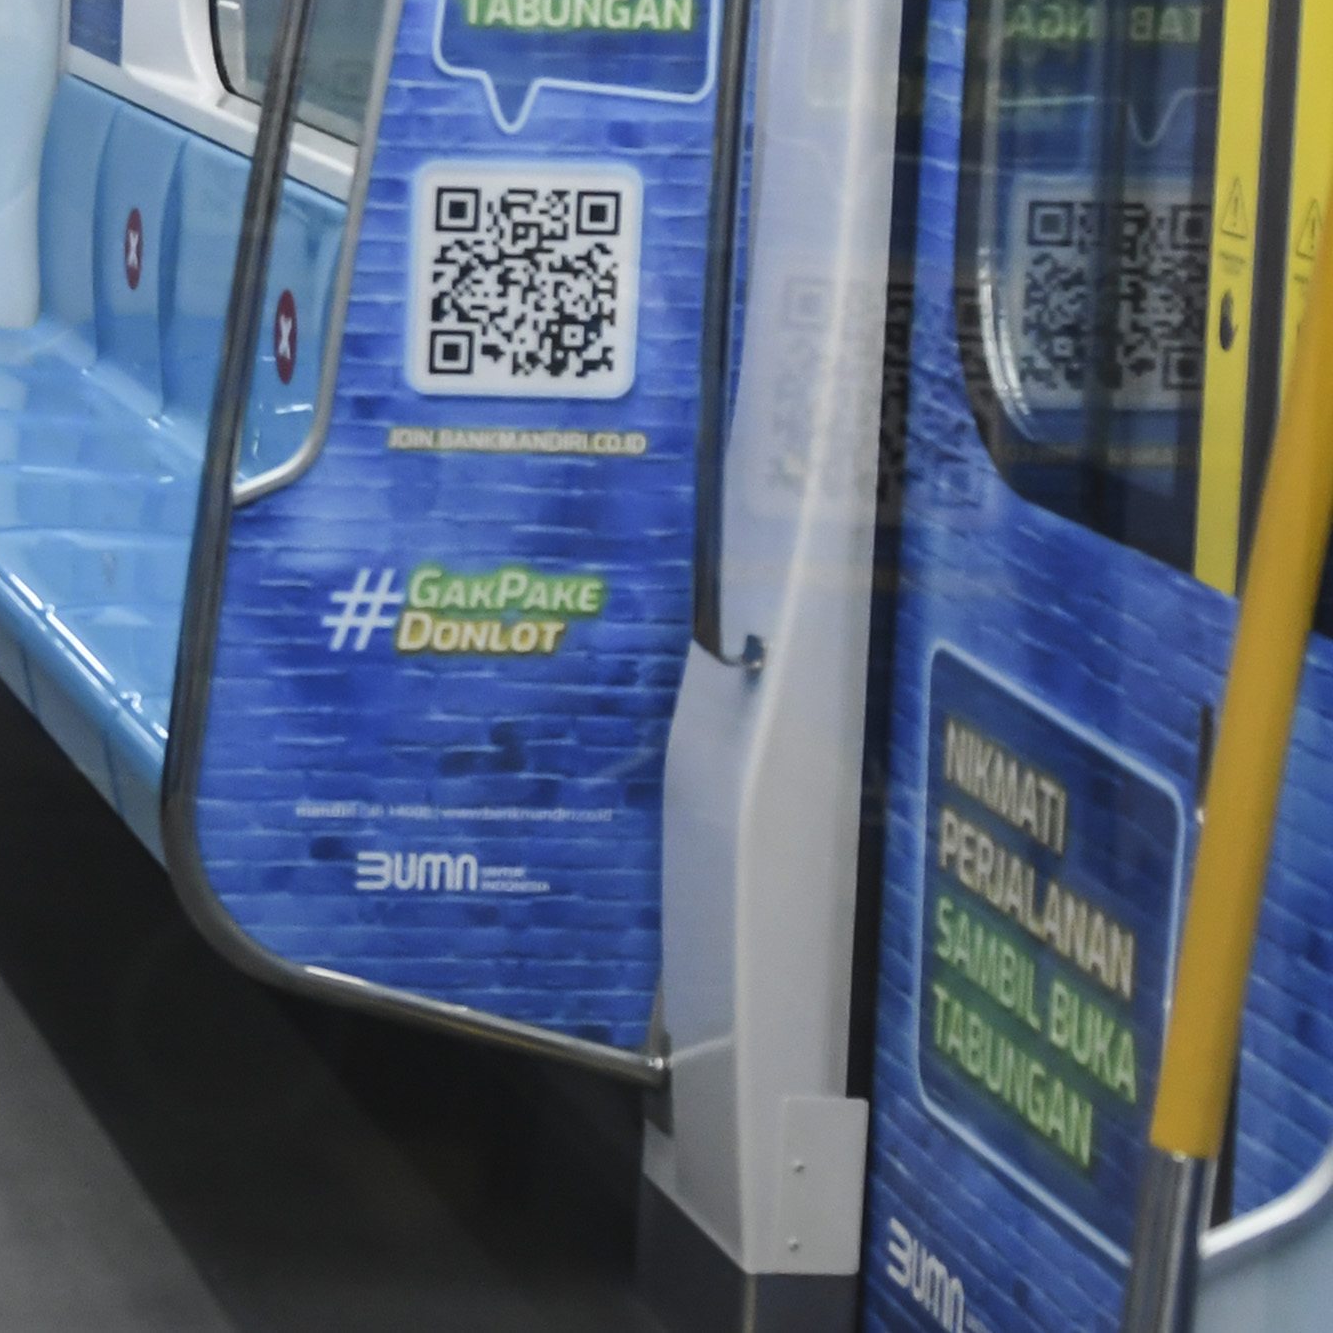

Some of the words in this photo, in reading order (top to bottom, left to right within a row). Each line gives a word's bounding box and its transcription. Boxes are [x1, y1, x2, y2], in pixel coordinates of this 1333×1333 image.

[945, 720, 1066, 856] NIKMATI
[939, 809, 1134, 1001] PERJALANAN
[932, 984, 1094, 1166] TABUNGAN
[936, 898, 1041, 1031] SAMBIL
[1048, 978, 1136, 1103] BUKA
